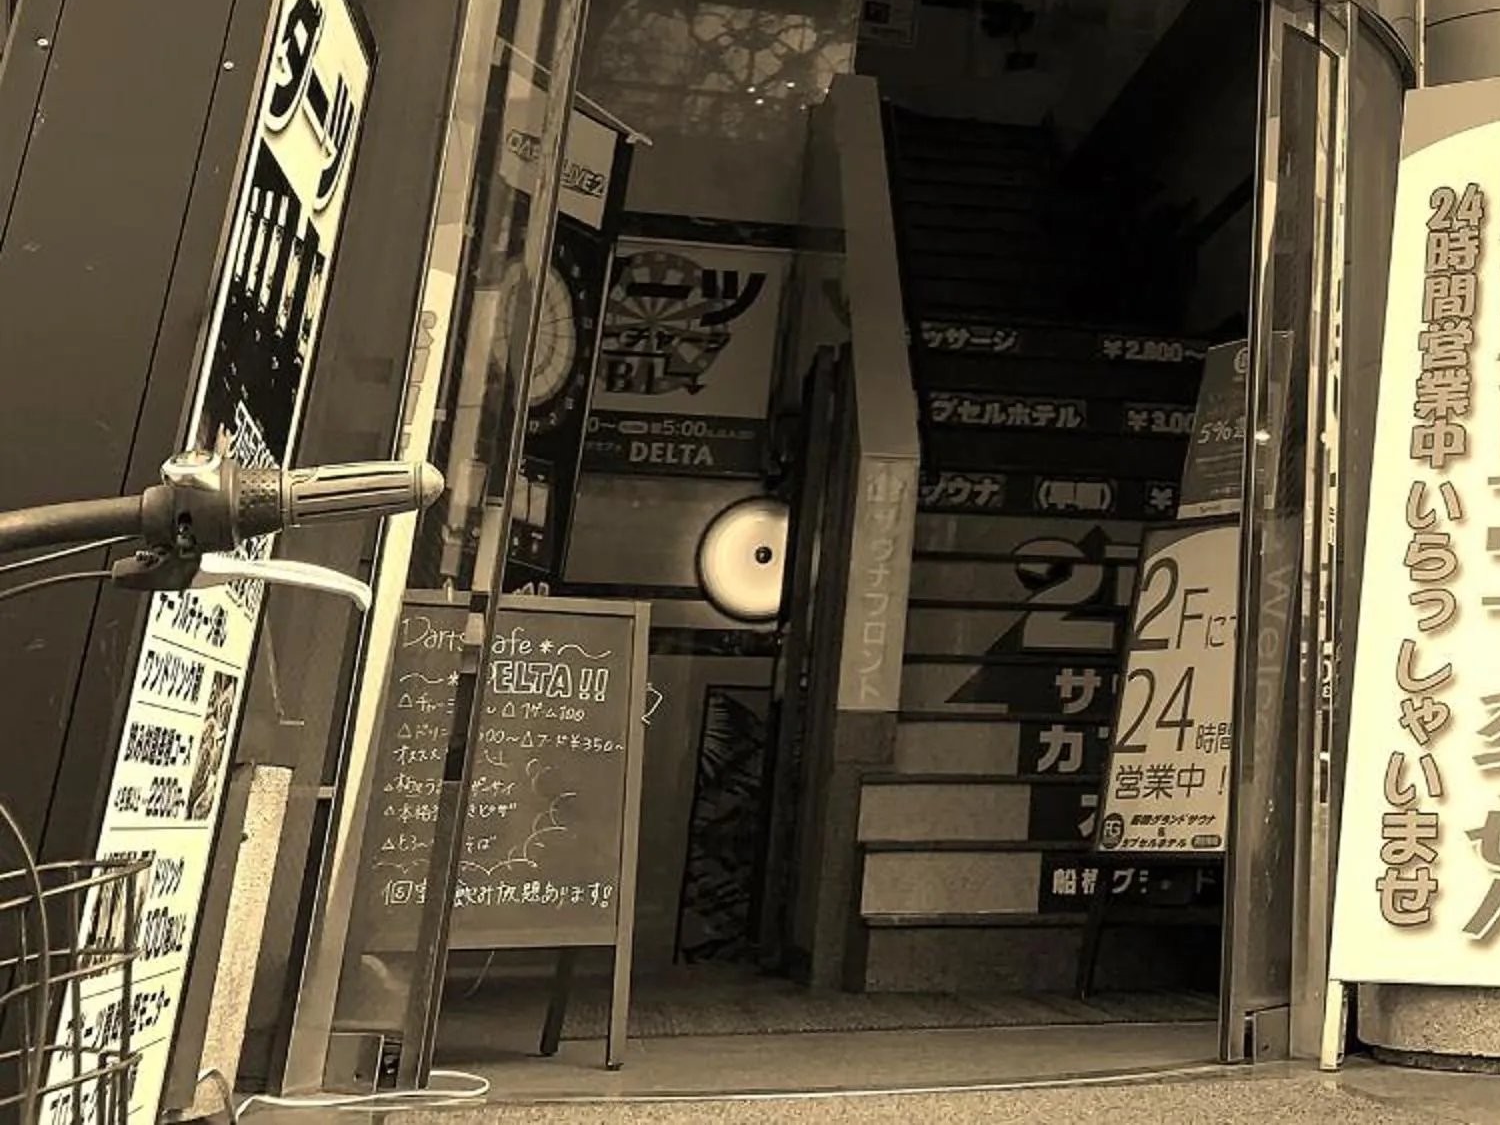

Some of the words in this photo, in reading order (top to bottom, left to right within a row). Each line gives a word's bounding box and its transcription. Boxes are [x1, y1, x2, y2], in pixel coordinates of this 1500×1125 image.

[920, 322, 1018, 352] ッサージ
[1411, 183, 1485, 468] 24時間営業中
[930, 396, 1083, 429] プセルホテル
[629, 441, 715, 467] DELTA
[488, 660, 610, 703] ELTA!!
[1375, 479, 1465, 932] いらっしゃいませ
